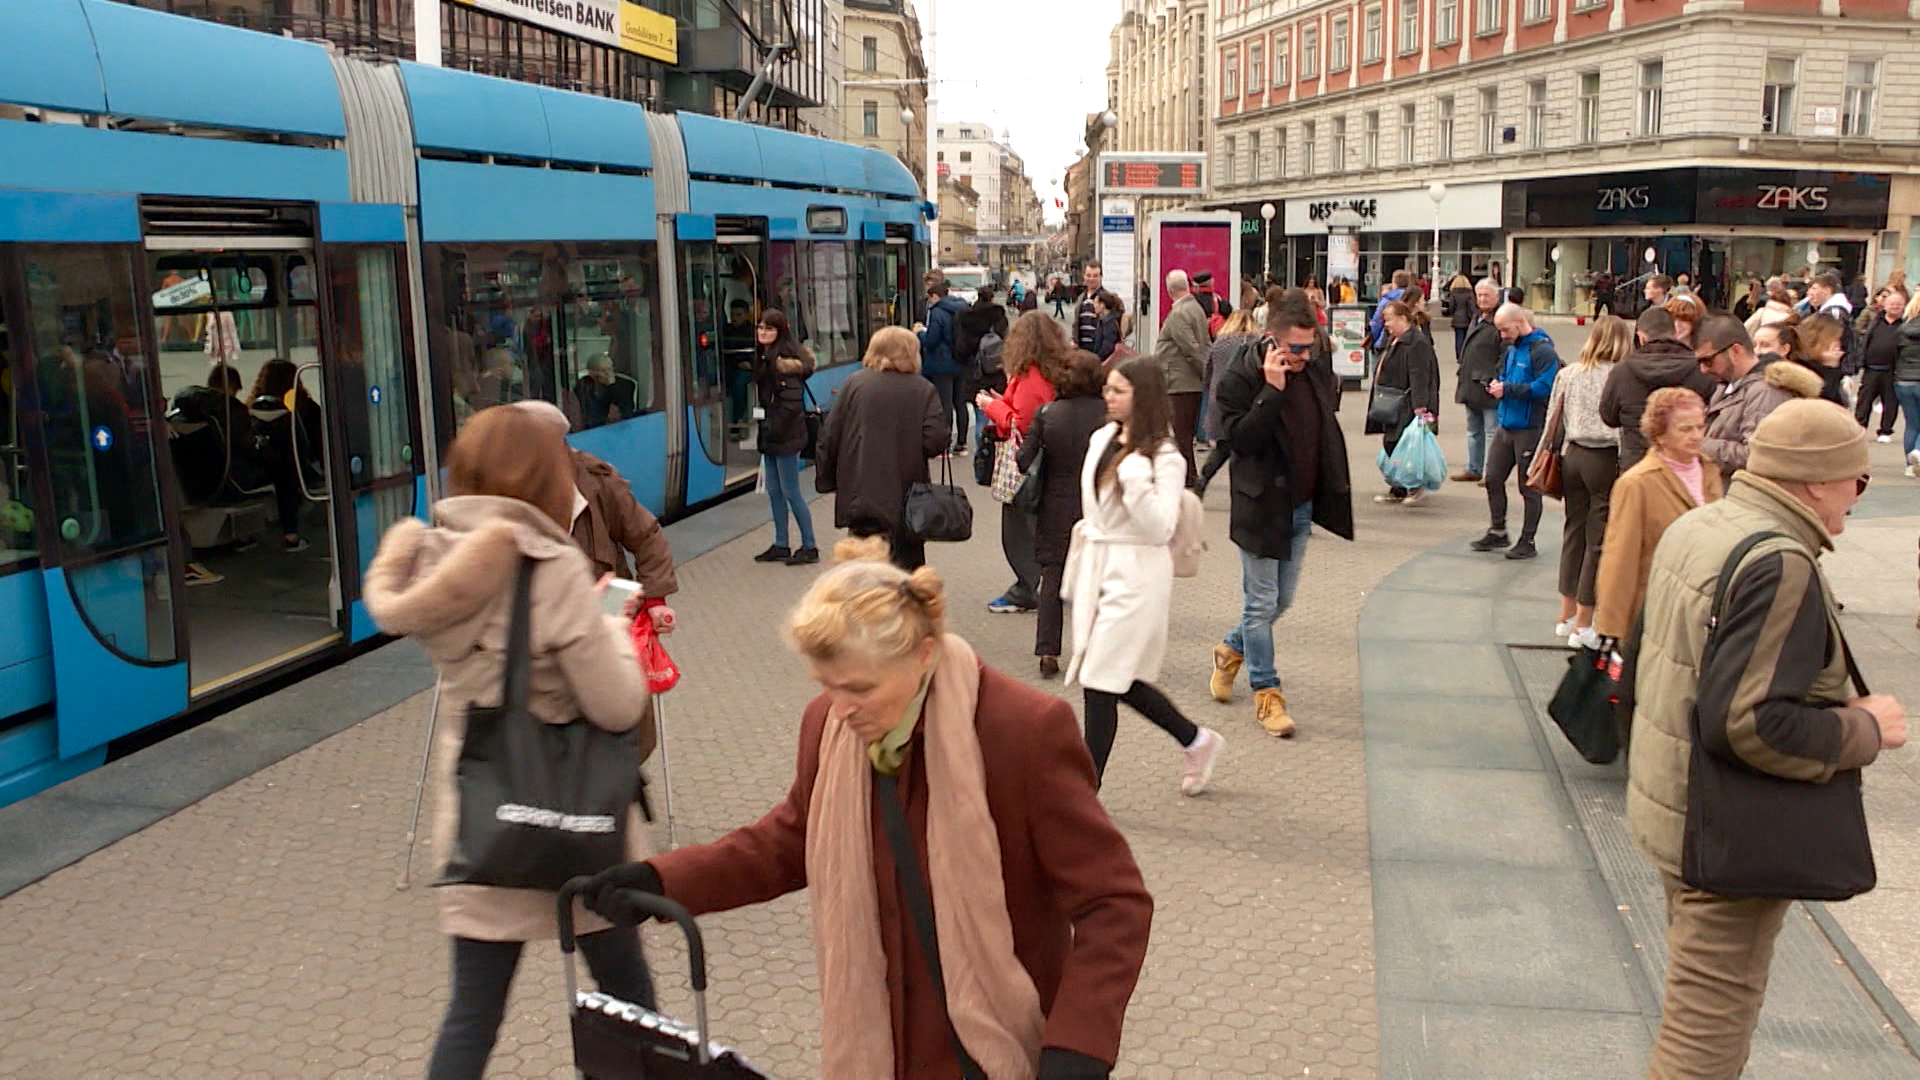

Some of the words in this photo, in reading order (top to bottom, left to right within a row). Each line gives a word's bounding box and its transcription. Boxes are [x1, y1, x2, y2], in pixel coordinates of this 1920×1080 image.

[575, 1, 615, 34] BANK
[1597, 185, 1649, 210] ZAKS
[1757, 185, 1828, 211] ZAKS
